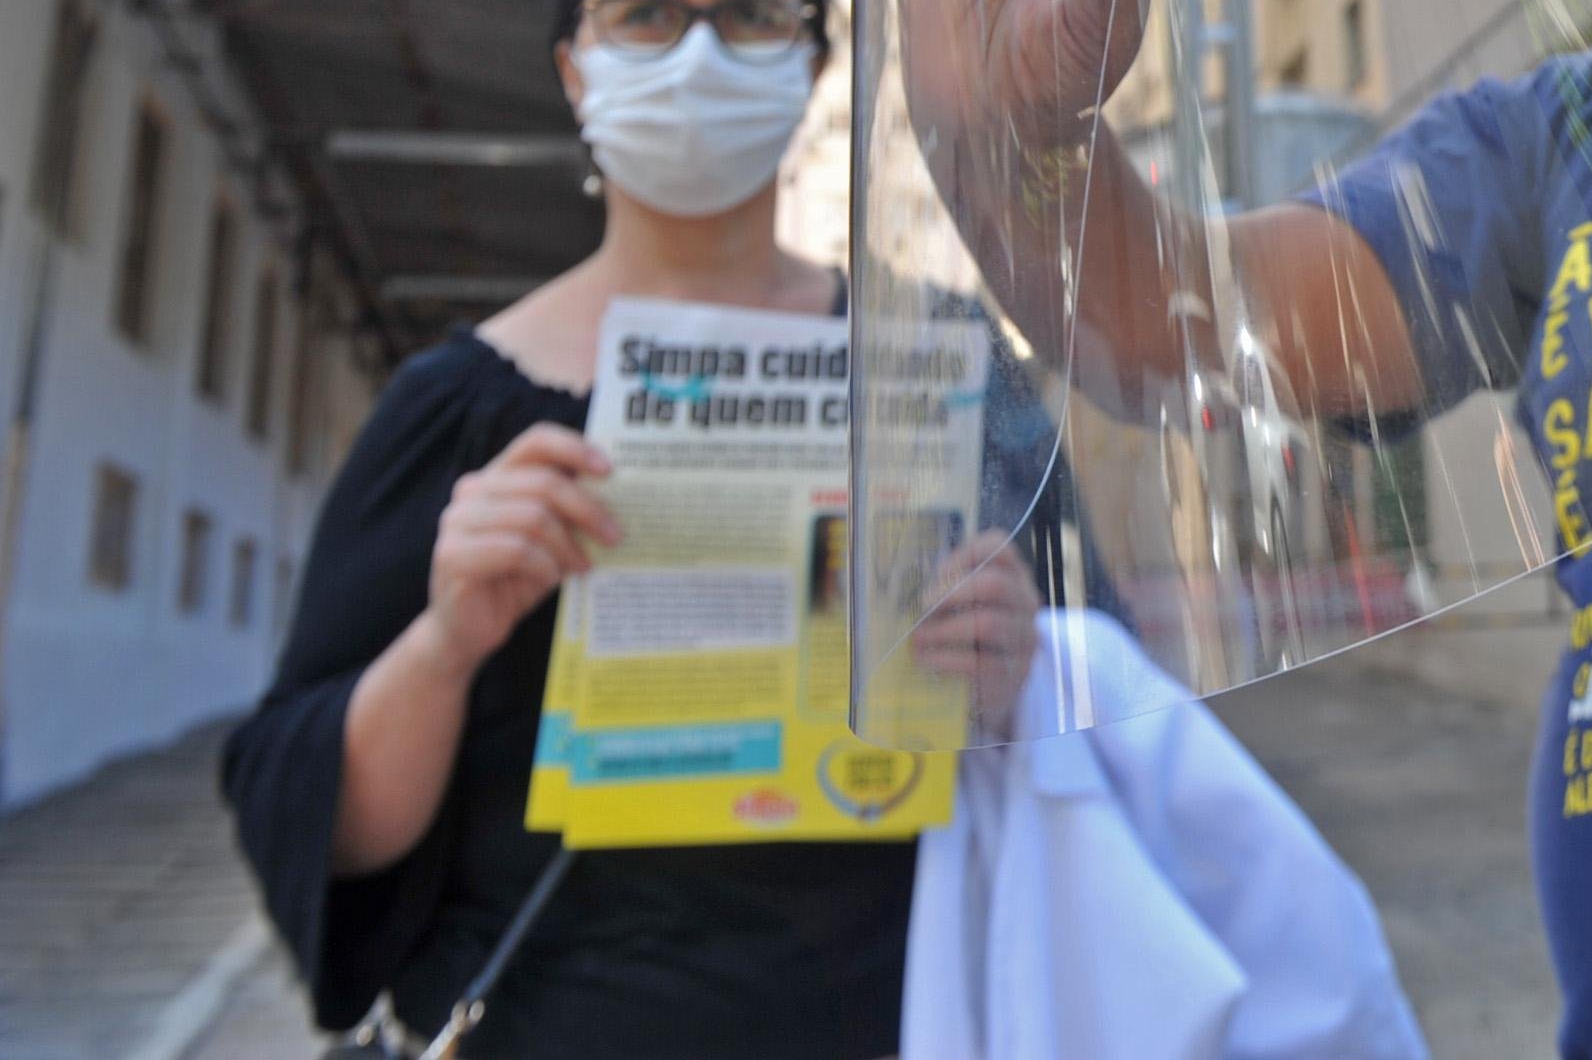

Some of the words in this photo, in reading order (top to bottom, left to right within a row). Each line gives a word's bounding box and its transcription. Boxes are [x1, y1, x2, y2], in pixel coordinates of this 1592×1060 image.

[618, 335, 745, 383] Simpa
[1542, 293, 1568, 379] É
[625, 388, 676, 425] de
[688, 388, 806, 429] quem
